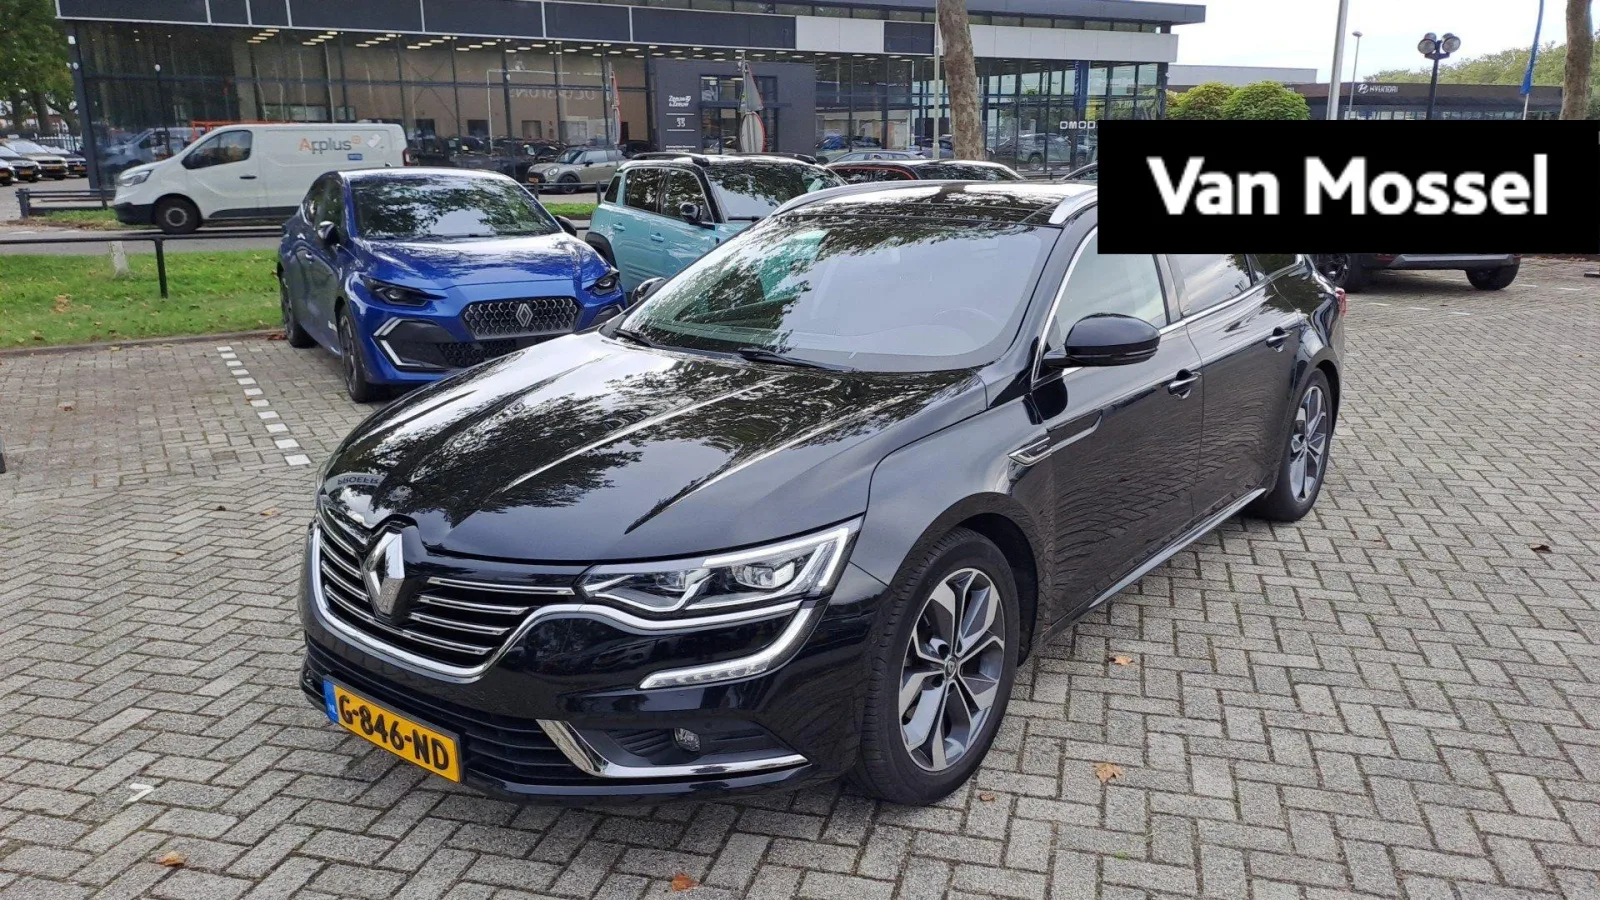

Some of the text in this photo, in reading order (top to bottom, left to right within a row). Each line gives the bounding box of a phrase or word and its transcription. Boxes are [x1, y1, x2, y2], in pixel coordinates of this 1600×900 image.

[1370, 85, 1398, 93] HYUNDAI
[1060, 120, 1098, 130] OMOD
[338, 695, 450, 770] G-846-ND
